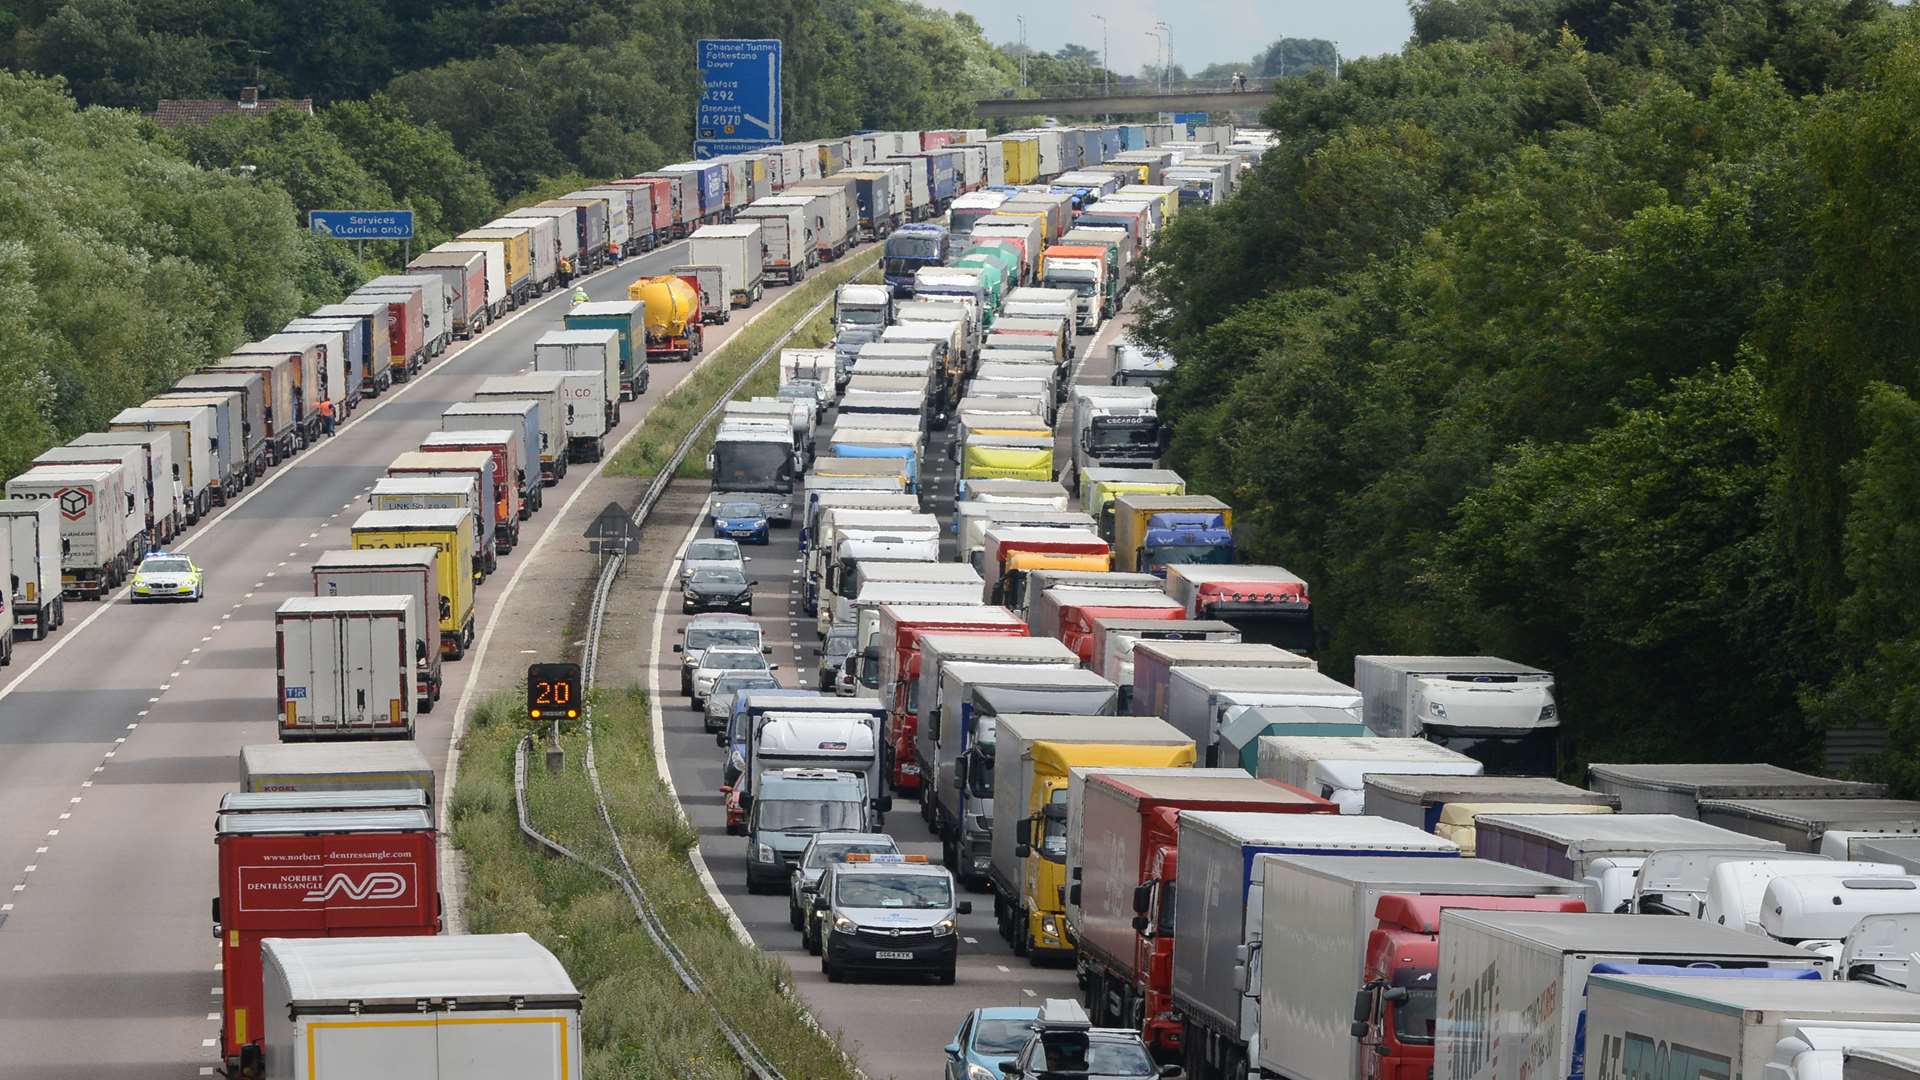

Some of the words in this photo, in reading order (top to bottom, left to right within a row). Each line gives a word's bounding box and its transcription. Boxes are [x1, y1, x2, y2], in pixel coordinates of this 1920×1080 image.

[705, 43, 744, 51] Channel
[746, 43, 777, 52] Tunnel
[705, 52, 758, 60] Folkestone
[702, 80, 738, 88] Ashford
[702, 90, 710, 101] A
[712, 90, 735, 101] 292
[702, 114, 710, 125] A
[712, 114, 741, 126] 2070
[349, 216, 396, 225] Services
[335, 225, 378, 234] (Lorries
[380, 225, 410, 236] only)
[287, 688, 305, 697] TIR
[536, 682, 569, 704] 20
[280, 874, 324, 882] NORBERT
[247, 882, 324, 891] DENTRESSANGLE
